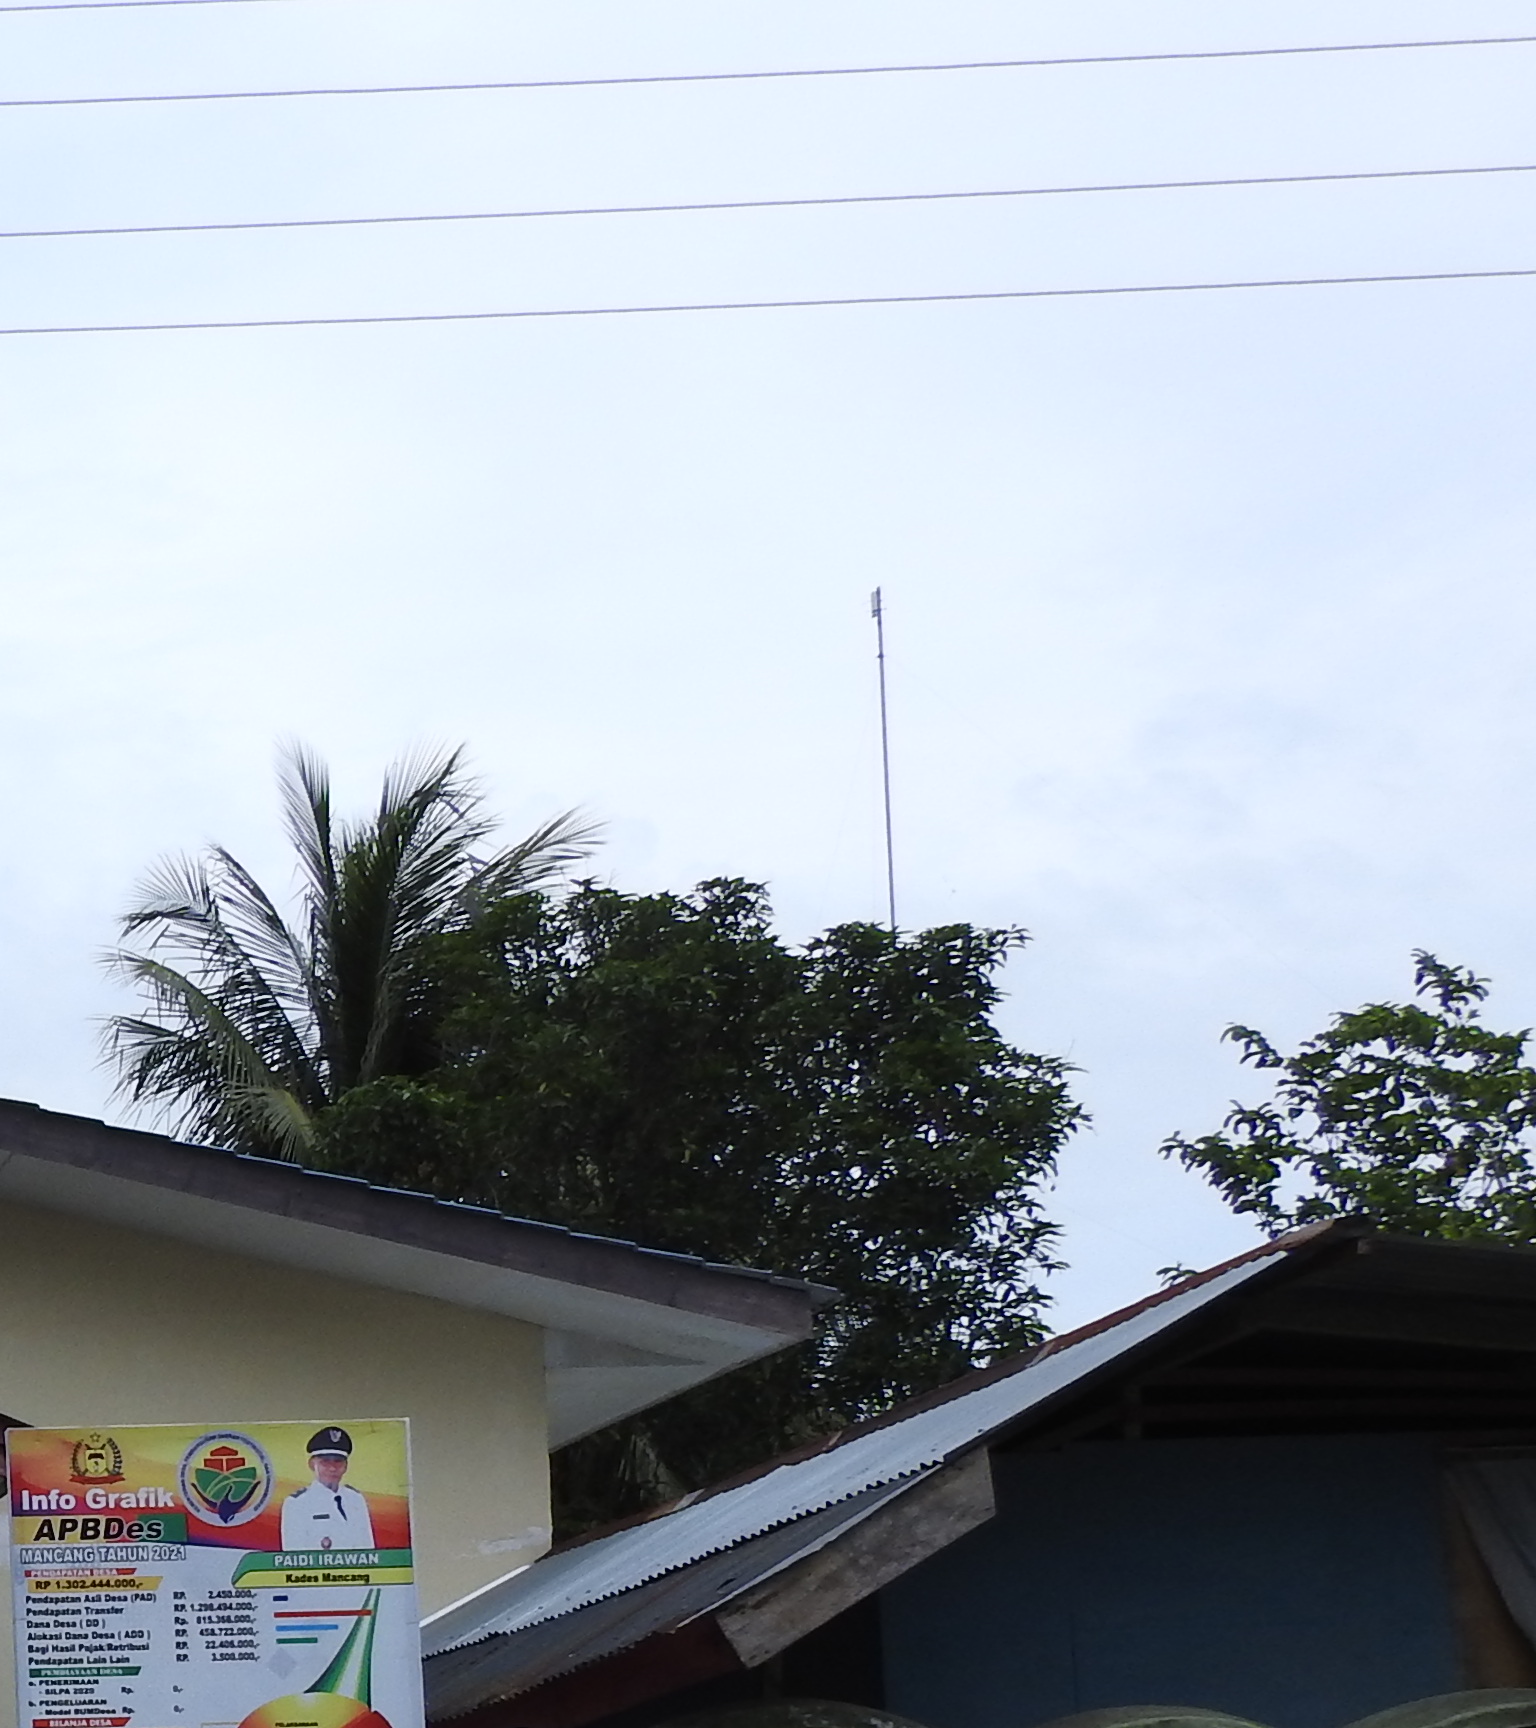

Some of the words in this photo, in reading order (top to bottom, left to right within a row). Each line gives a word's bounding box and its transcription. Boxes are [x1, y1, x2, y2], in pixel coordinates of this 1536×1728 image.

[21, 1489, 76, 1511] Info
[85, 1486, 176, 1510] Grafik
[32, 1517, 165, 1542] APBDes
[20, 1547, 95, 1564] MANCANG
[98, 1546, 151, 1563] TAHUN
[153, 1544, 187, 1561] 2021
[274, 1555, 313, 1567] PAIDI
[318, 1553, 379, 1566] IRAWAN
[285, 1573, 319, 1583] Kades
[321, 1573, 370, 1584] Mancang
